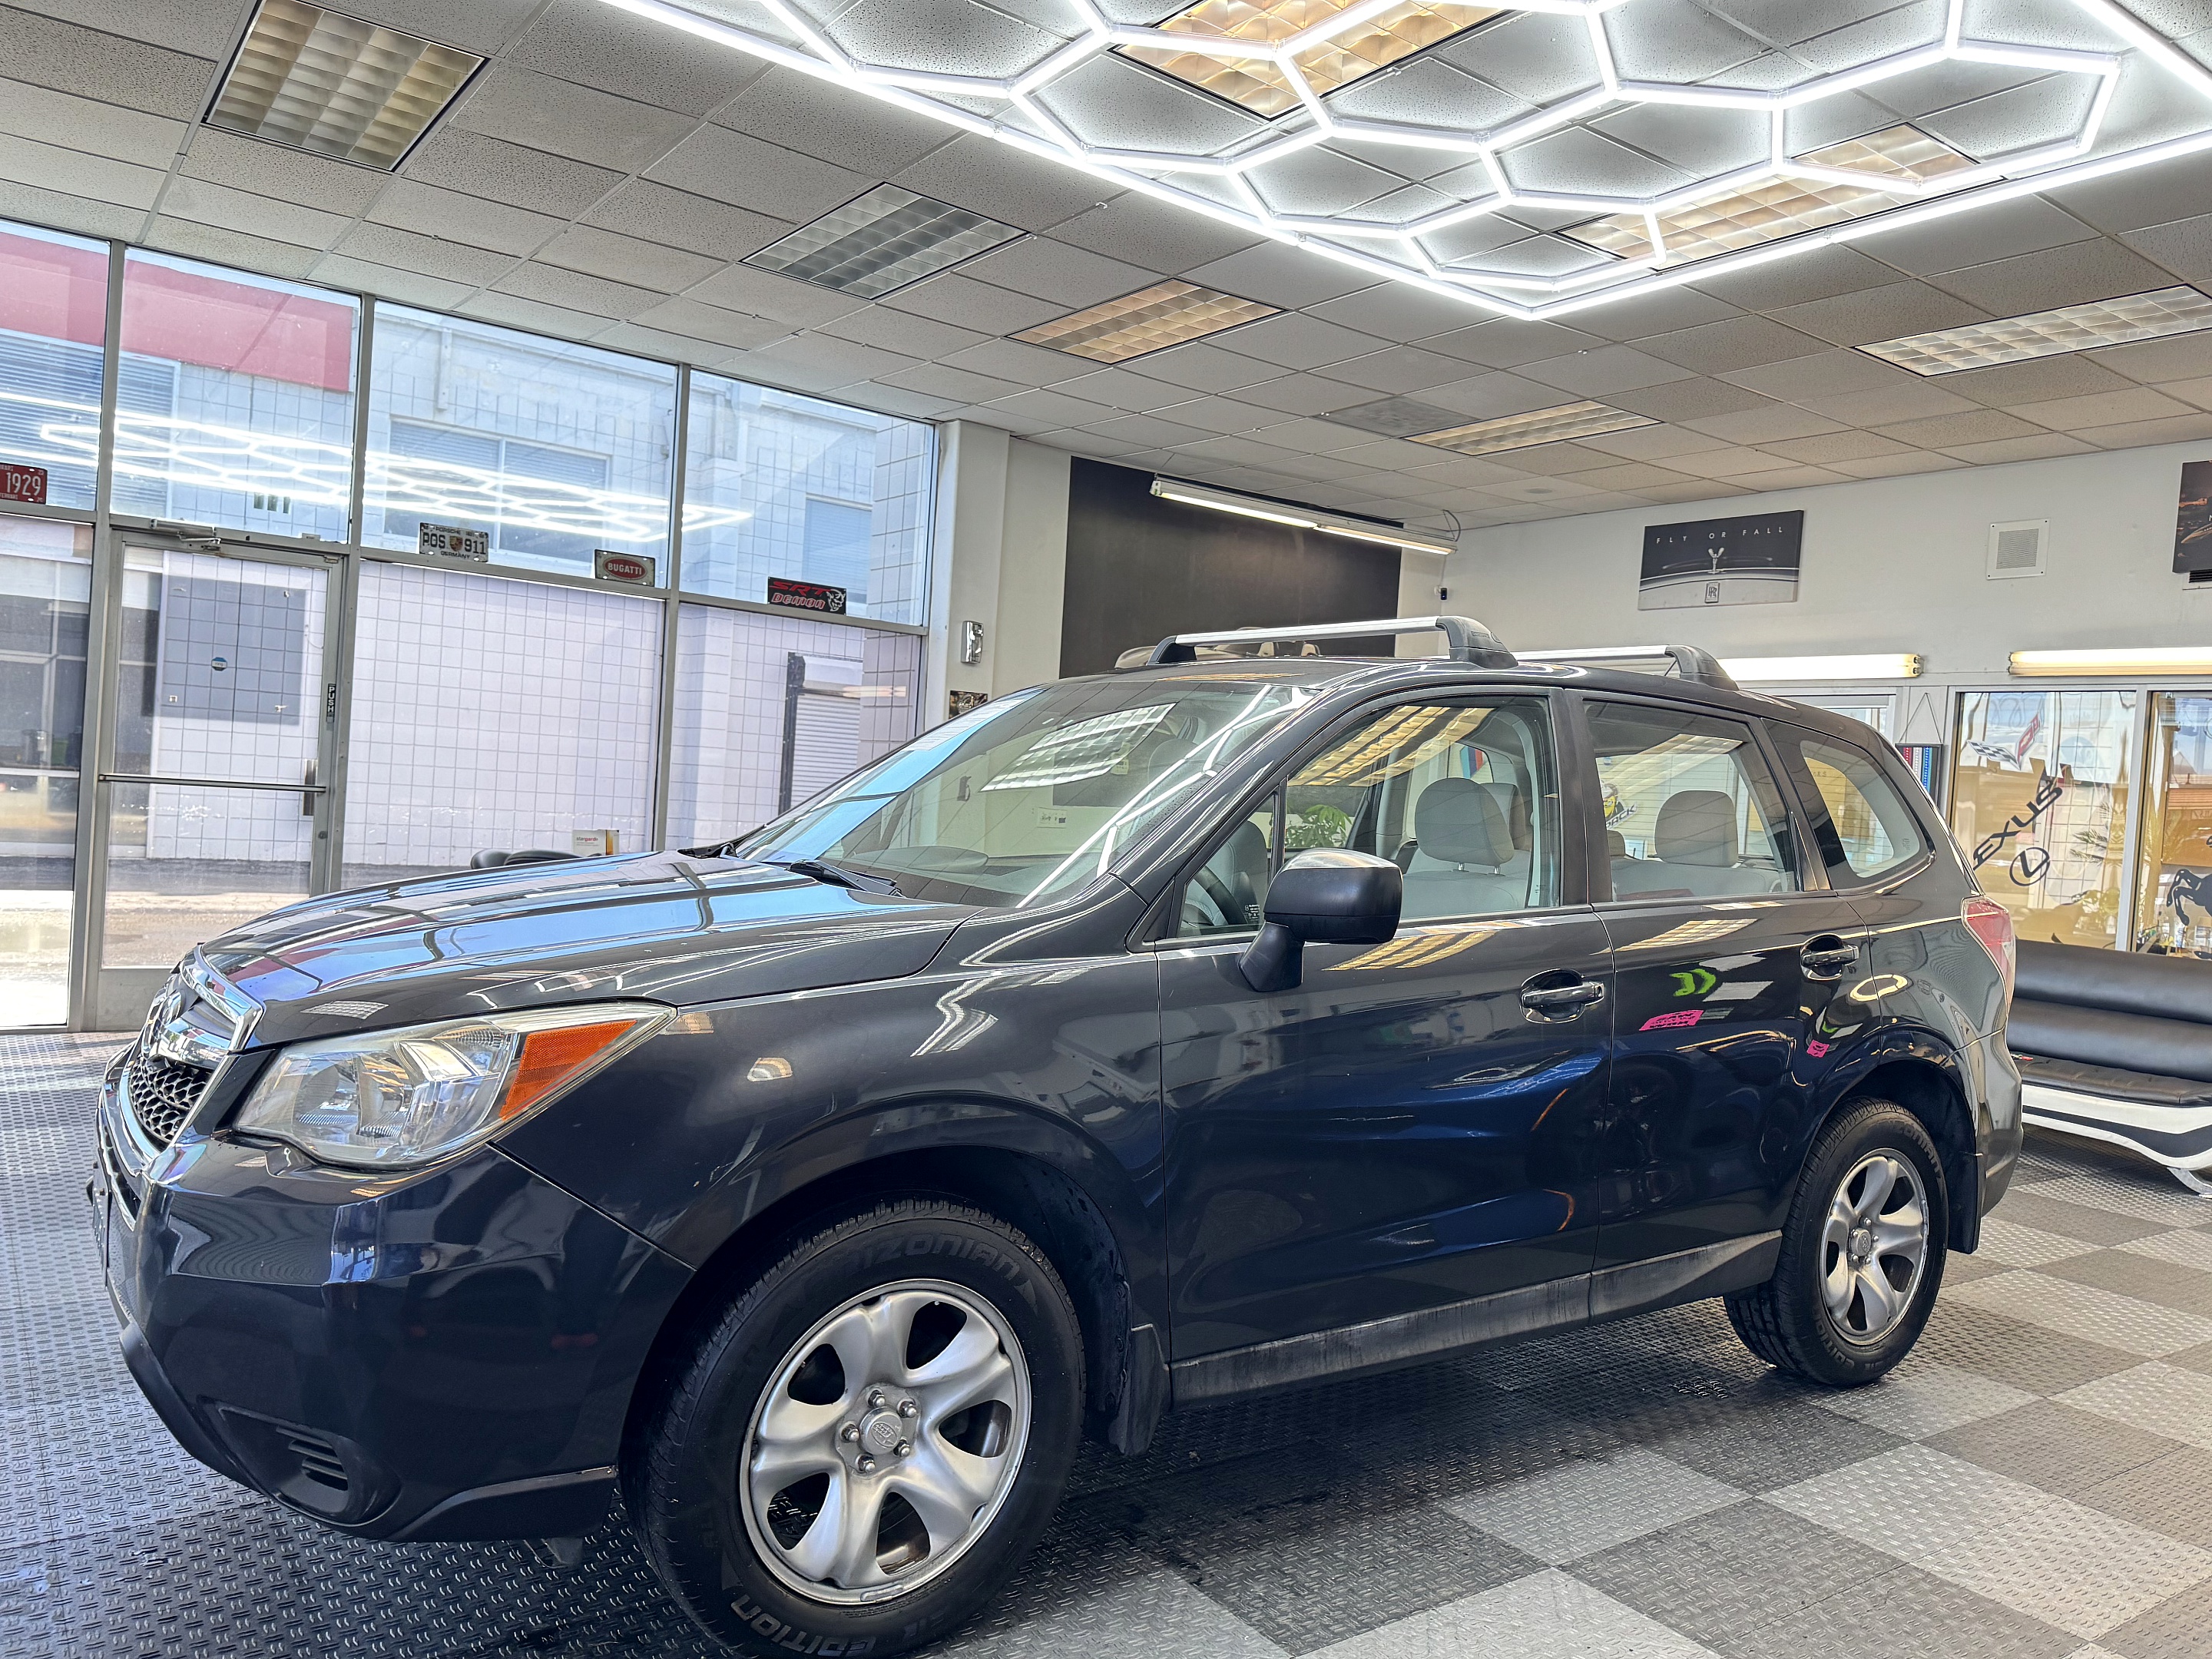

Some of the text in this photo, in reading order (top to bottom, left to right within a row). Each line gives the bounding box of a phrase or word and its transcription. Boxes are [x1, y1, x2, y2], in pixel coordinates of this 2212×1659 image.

[7, 472, 41, 496] 1929
[436, 526, 461, 535] PORSCHE
[1743, 526, 1782, 536] FALL
[423, 532, 486, 555] POS 911
[441, 551, 470, 559] GERMANY
[608, 563, 641, 575] BUGATTI
[770, 581, 831, 596] SRT
[771, 592, 826, 610] DEMON
[1973, 782, 2063, 871] EXUS
[731, 1594, 877, 1657] EDITION
